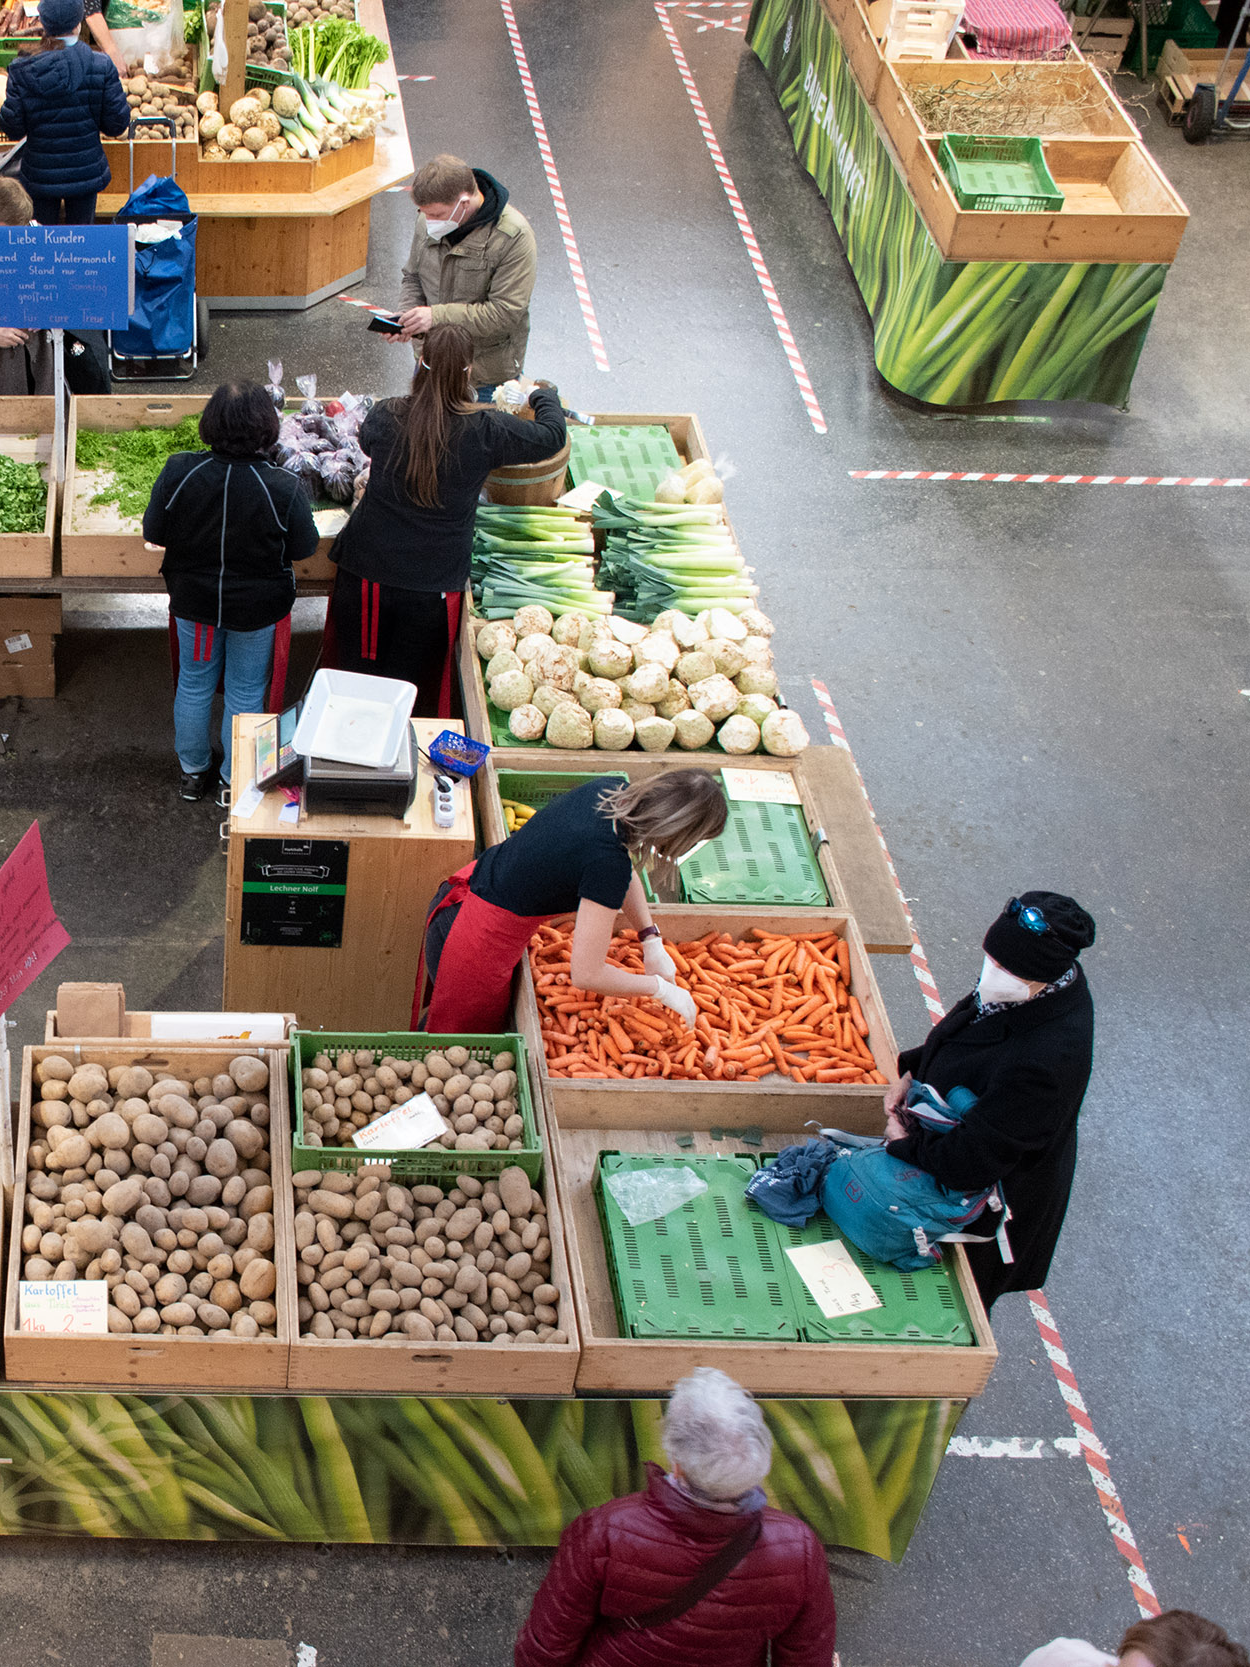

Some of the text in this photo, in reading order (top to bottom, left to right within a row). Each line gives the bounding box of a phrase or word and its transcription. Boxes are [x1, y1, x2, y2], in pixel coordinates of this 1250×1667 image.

[804, 61, 865, 204] BAUERNMARKT
[8, 228, 85, 244] Liebe Kunden
[30, 252, 46, 262] der
[54, 250, 117, 264] Wintermonate
[29, 266, 55, 276] Stand
[18, 280, 36, 290] und
[358, 1106, 413, 1140] Kartoffel
[24, 1283, 78, 1300] Kartoffel
